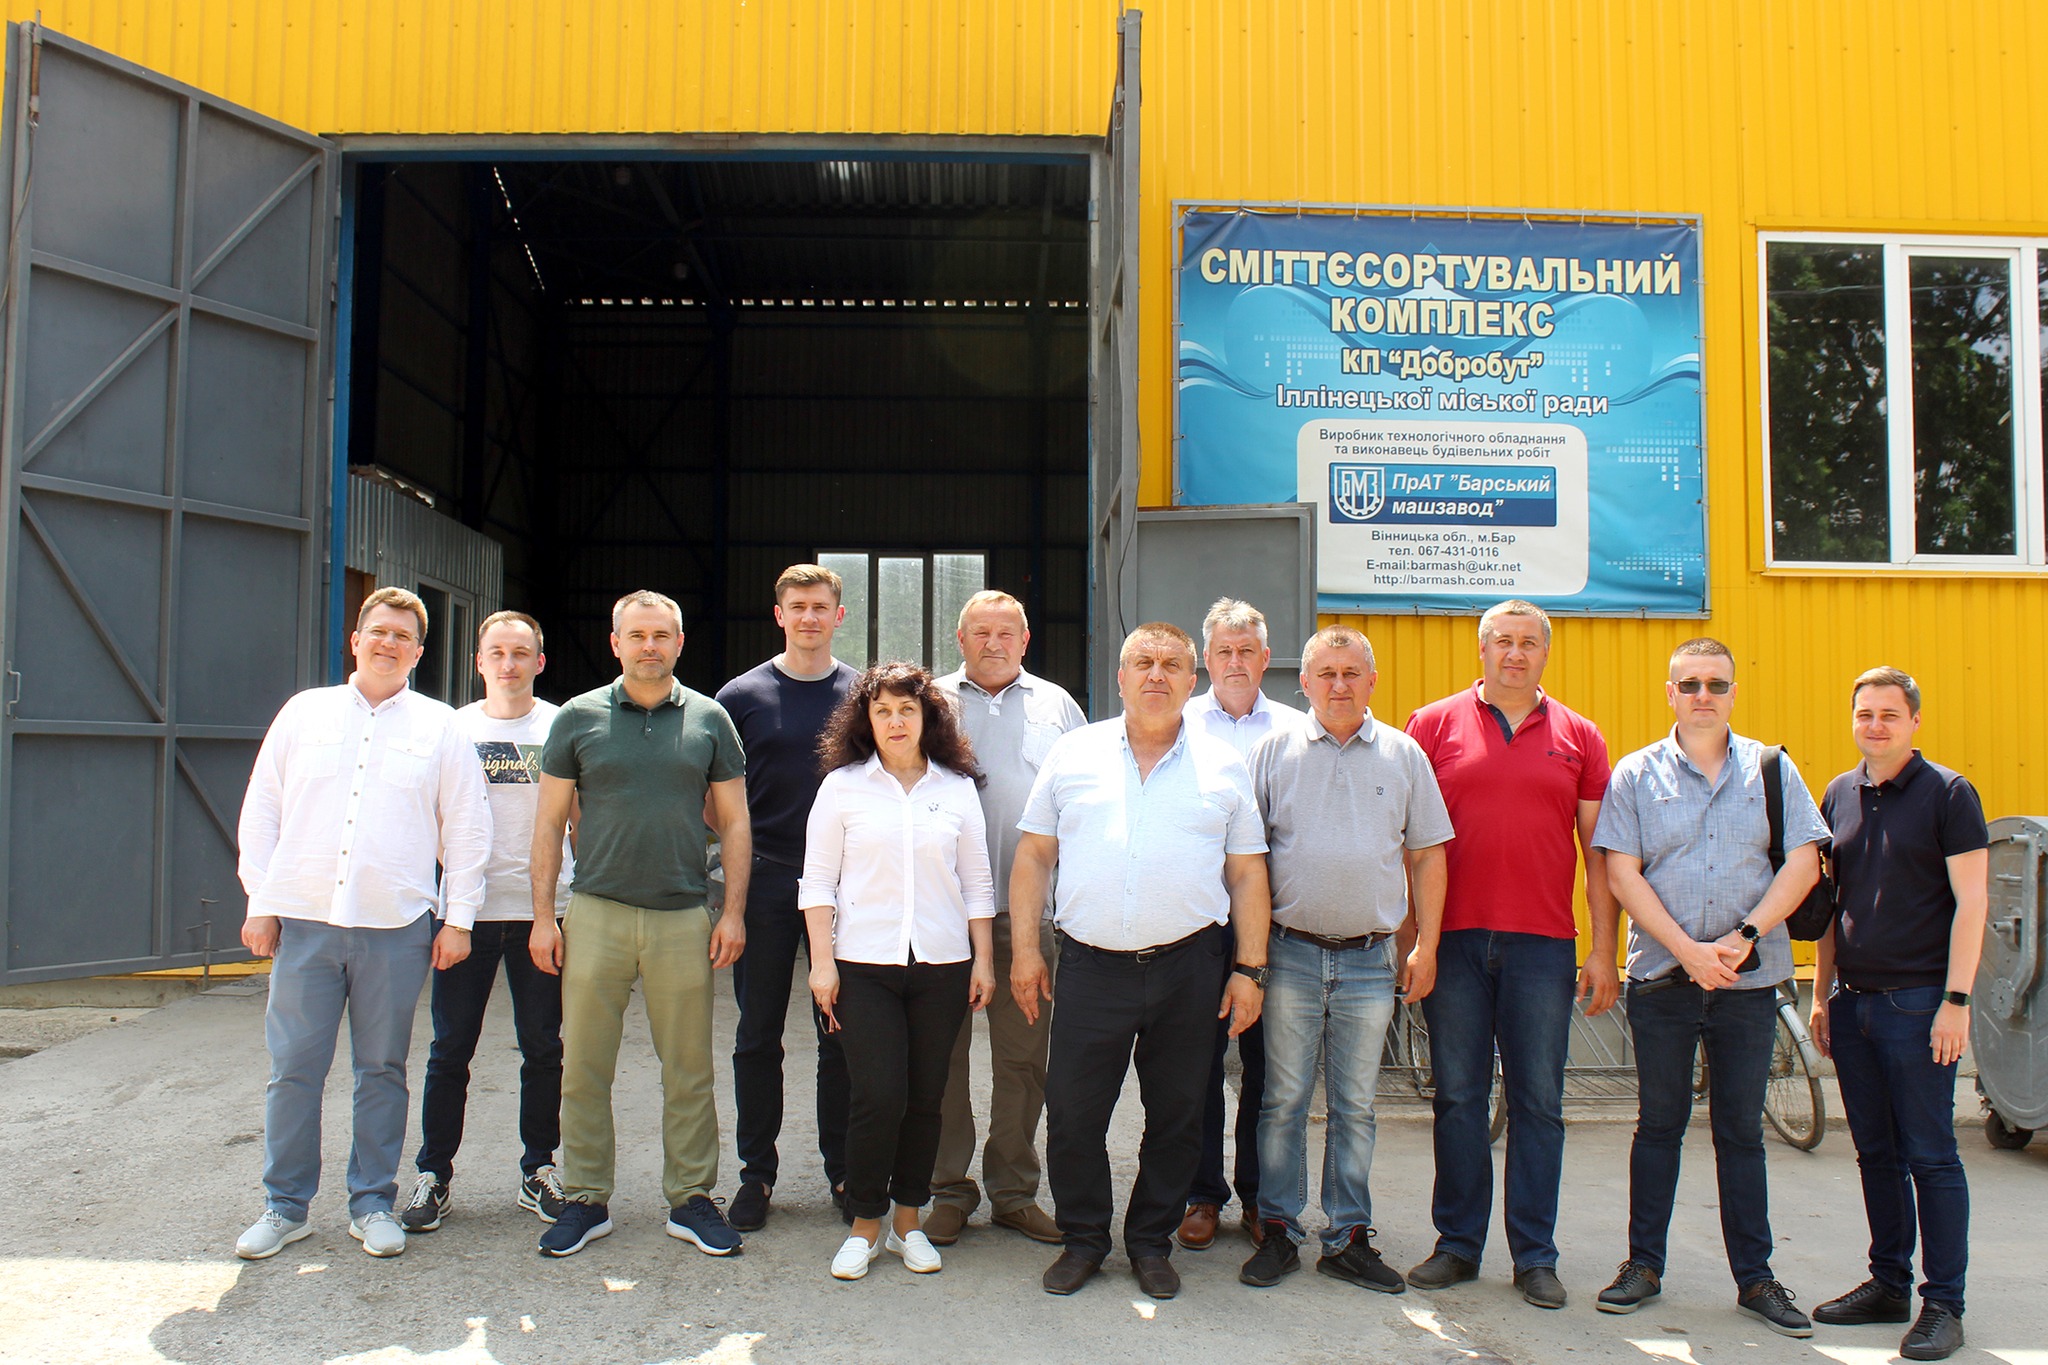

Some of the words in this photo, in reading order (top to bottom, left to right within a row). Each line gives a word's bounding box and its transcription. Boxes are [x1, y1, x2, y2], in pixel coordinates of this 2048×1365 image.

[1199, 247, 1681, 295] СМІТТЄСОРТУВАЛЬНИЙ
[1330, 297, 1555, 337] КОМПЛЕКС
[1342, 348, 1381, 374] КП
[1277, 385, 1433, 412] Іллінецької
[1439, 387, 1537, 412] міської
[1543, 396, 1609, 417] ради
[1320, 429, 1384, 442] Виробник
[1387, 431, 1485, 443] технологічного
[1488, 433, 1566, 446] обладнання
[1334, 445, 1348, 455] та
[1352, 446, 1429, 457] виконавець
[1432, 445, 1513, 460] будівельних
[1517, 447, 1551, 460] робіт
[1392, 473, 1444, 492] ПрАТ
[1371, 530, 1440, 543] Вінницька
[1443, 532, 1474, 544] обл.,
[1478, 532, 1516, 545] м.Бар
[1388, 546, 1414, 556] тел.
[1418, 545, 1499, 557] 067-431-0116
[1366, 560, 1521, 573] E-mail:barmash@ukr.net
[1374, 574, 1515, 587] http://barmash.com.ua
